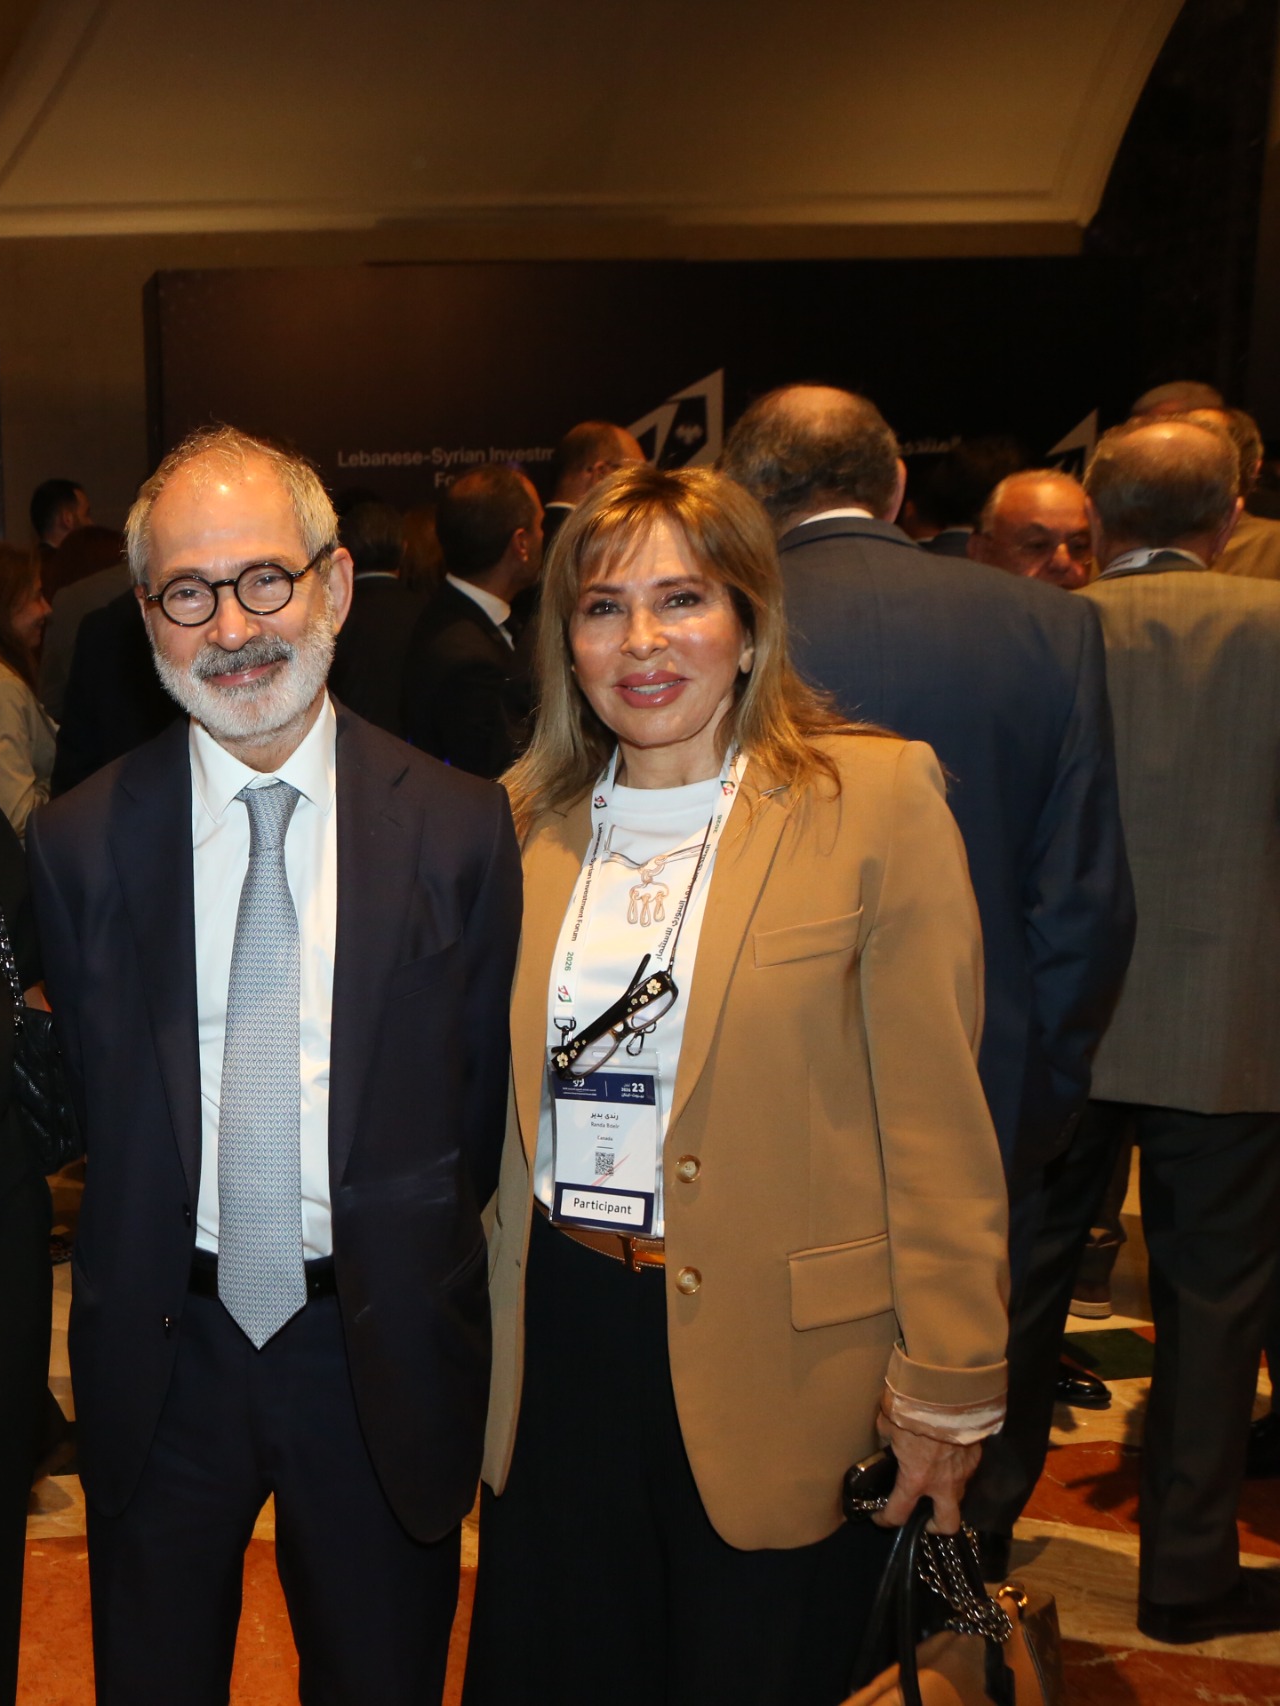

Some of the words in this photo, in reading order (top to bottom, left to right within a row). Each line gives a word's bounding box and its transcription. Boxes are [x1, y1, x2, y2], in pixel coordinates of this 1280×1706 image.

[337, 446, 486, 468] Lebanese-Syrian
[578, 880, 591, 918] Investment
[571, 919, 582, 942] Forum
[564, 951, 574, 971] 2026
[632, 1082, 645, 1092] 23
[573, 1197, 632, 1214] Participant
